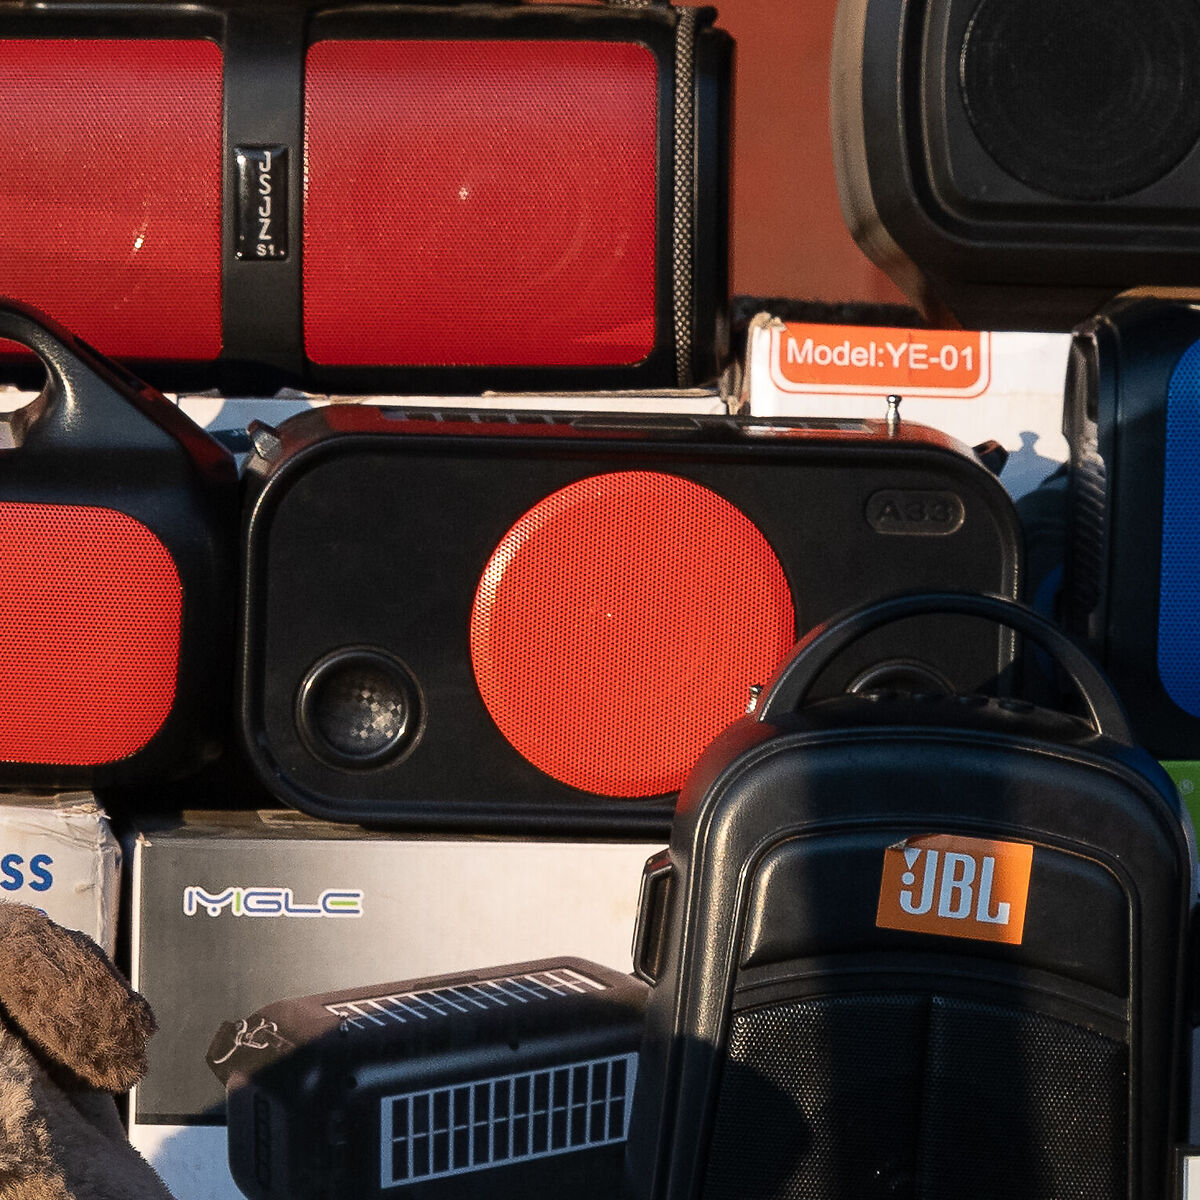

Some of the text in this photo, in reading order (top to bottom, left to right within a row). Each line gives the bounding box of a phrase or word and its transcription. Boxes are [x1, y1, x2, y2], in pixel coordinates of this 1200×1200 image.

[256, 243, 275, 257] S1
[786, 337, 974, 371] Model:YE-01
[899, 848, 1011, 925] JBL
